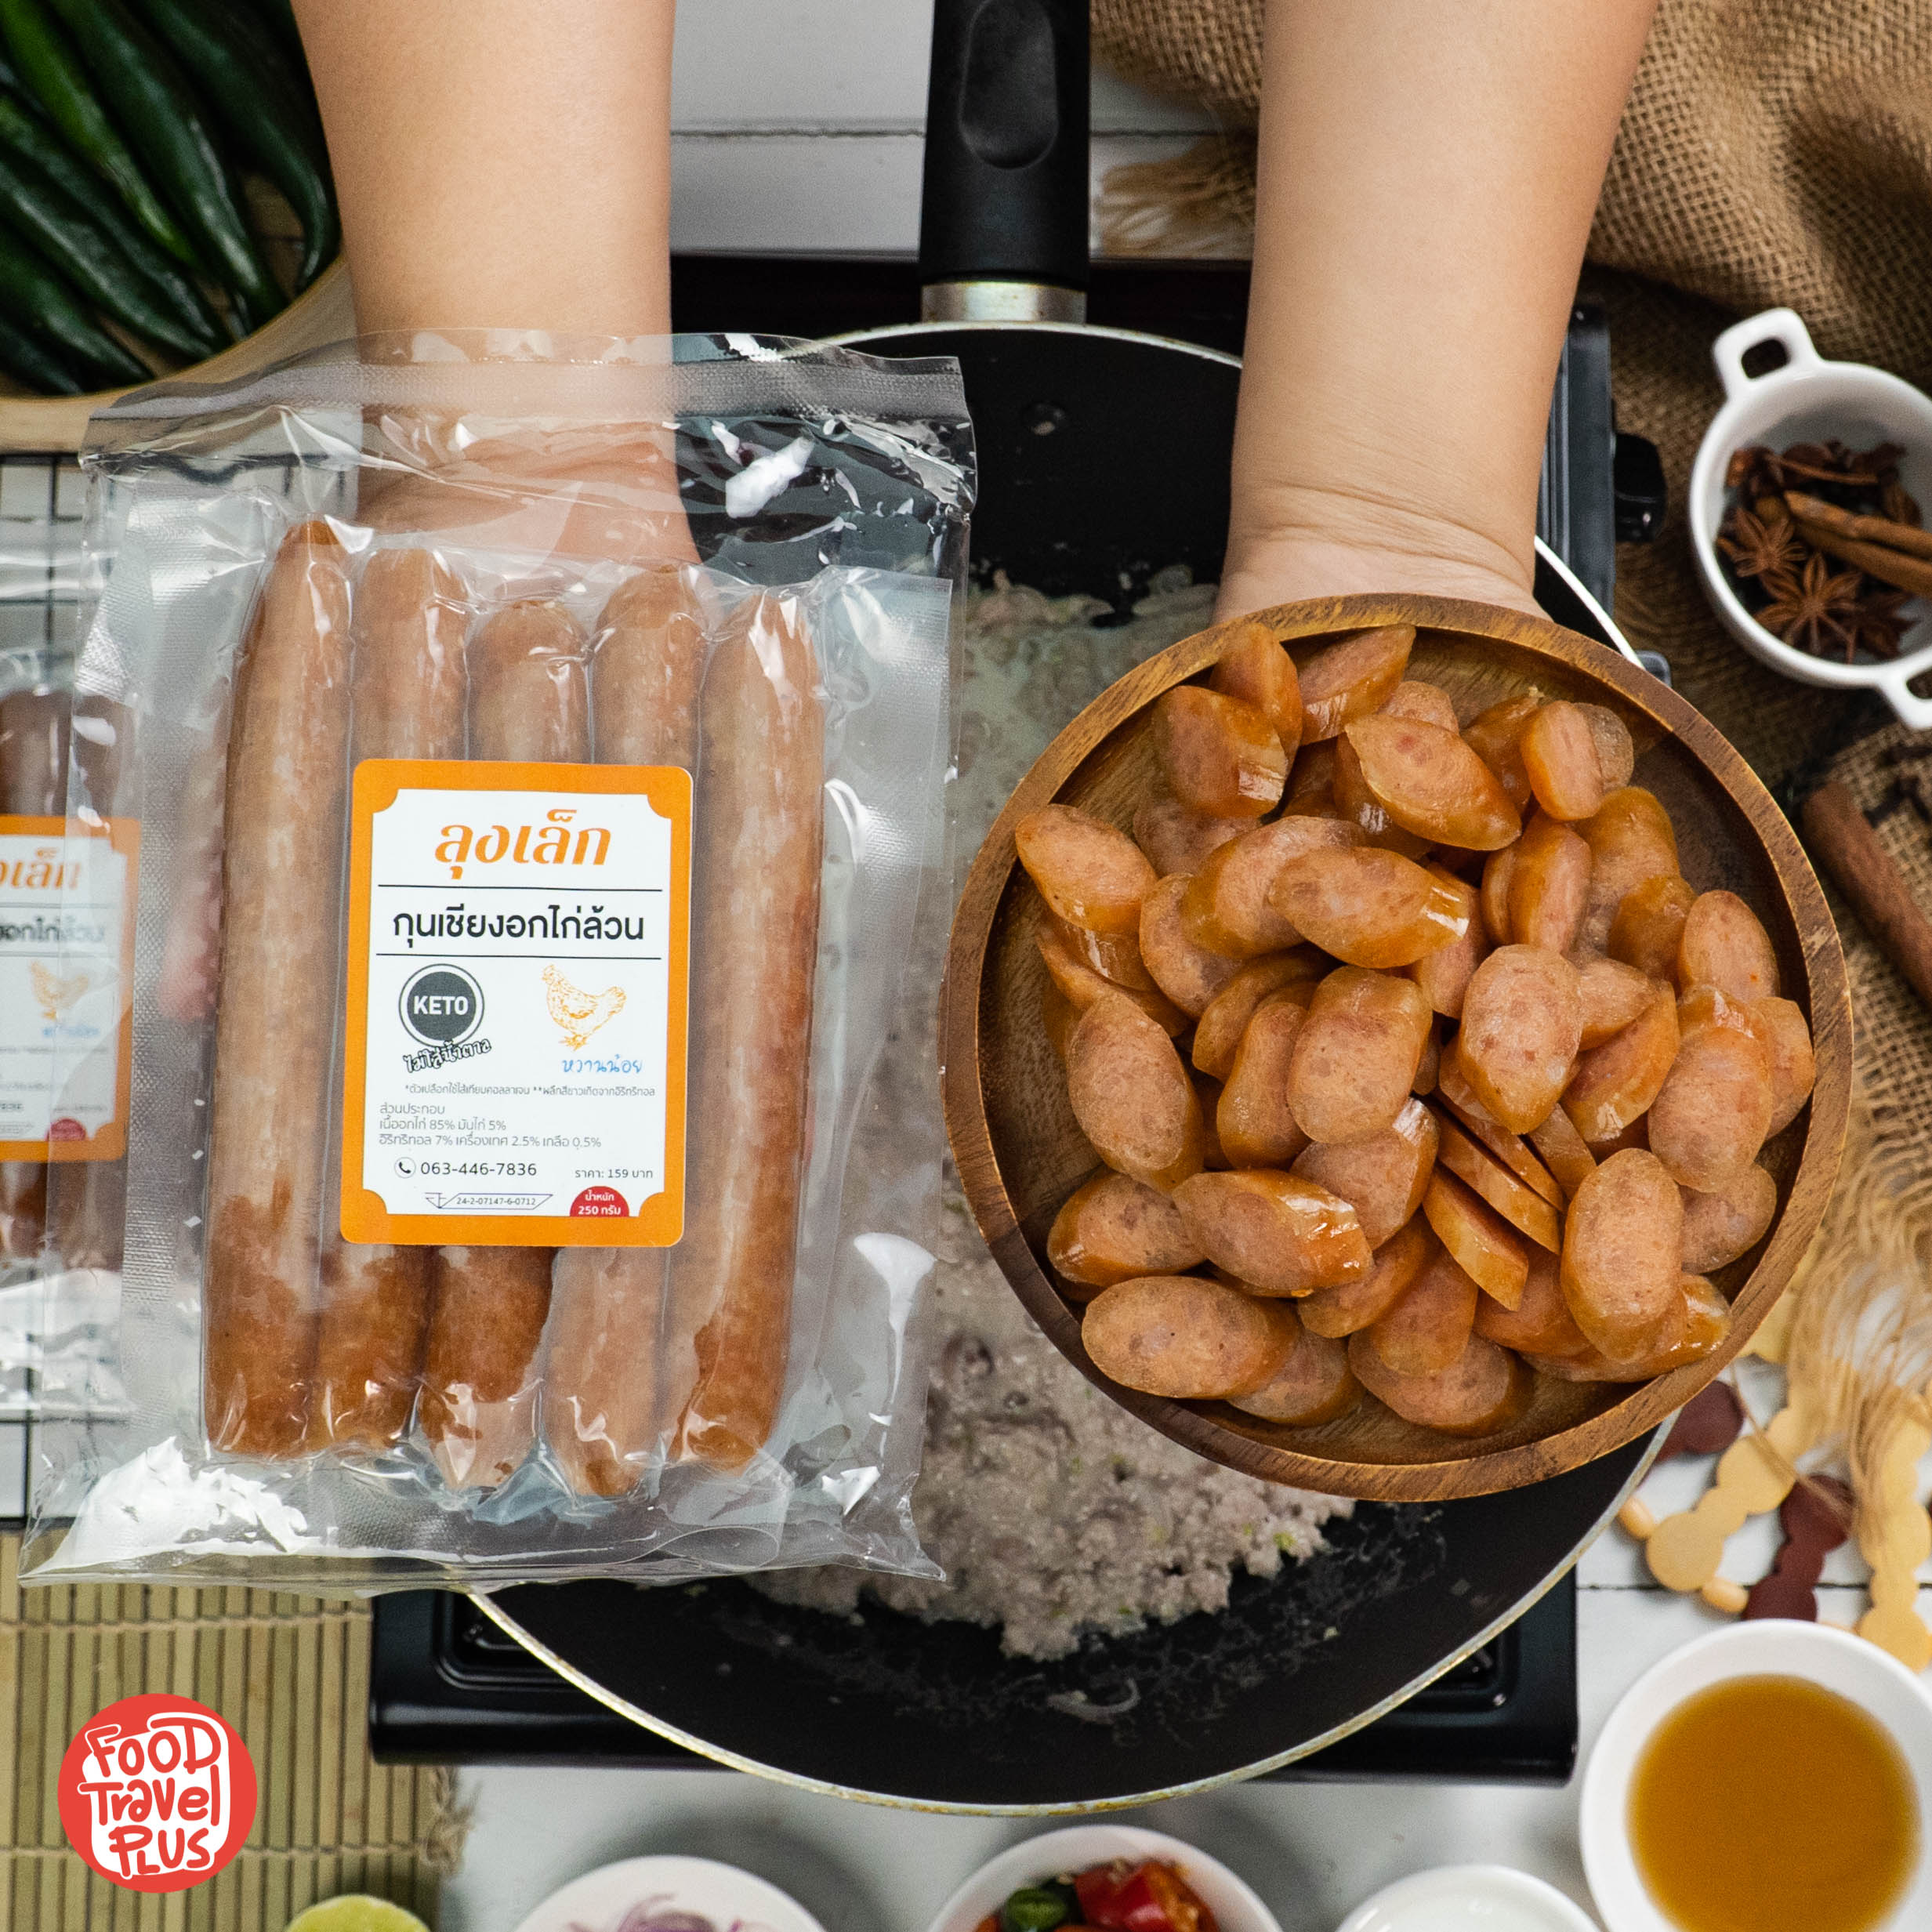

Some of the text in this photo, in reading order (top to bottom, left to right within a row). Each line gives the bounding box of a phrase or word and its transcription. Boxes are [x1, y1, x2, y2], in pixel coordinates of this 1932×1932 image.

[435, 809, 611, 879] ลุงเล็ก
[393, 904, 644, 948] กุนเชียงอกไก่ล้วน
[413, 995, 469, 1015] KETO
[403, 1038, 492, 1073] ไม่ใส่น้ำตาล
[561, 1054, 643, 1075] หวานน้อย
[379, 1102, 445, 1115] ส่วนประกอบ
[379, 1115, 506, 1131] เนื้ออกไก่ 85% มันไก่ 5%
[435, 1135, 453, 1146] 7%
[456, 1133, 509, 1146] เครื่องเทศ
[511, 1136, 540, 1147] 2.5%
[542, 1135, 570, 1147] เกลือ
[572, 1136, 601, 1149] 0.5%
[420, 1162, 538, 1176] 063-446-7836
[575, 1169, 654, 1179] ราคา: 159 บาท
[456, 1197, 536, 1205] 24-2-07147-6-0712
[585, 1190, 614, 1202] น้ำหนัก
[578, 1204, 622, 1216] 250 กรัม
